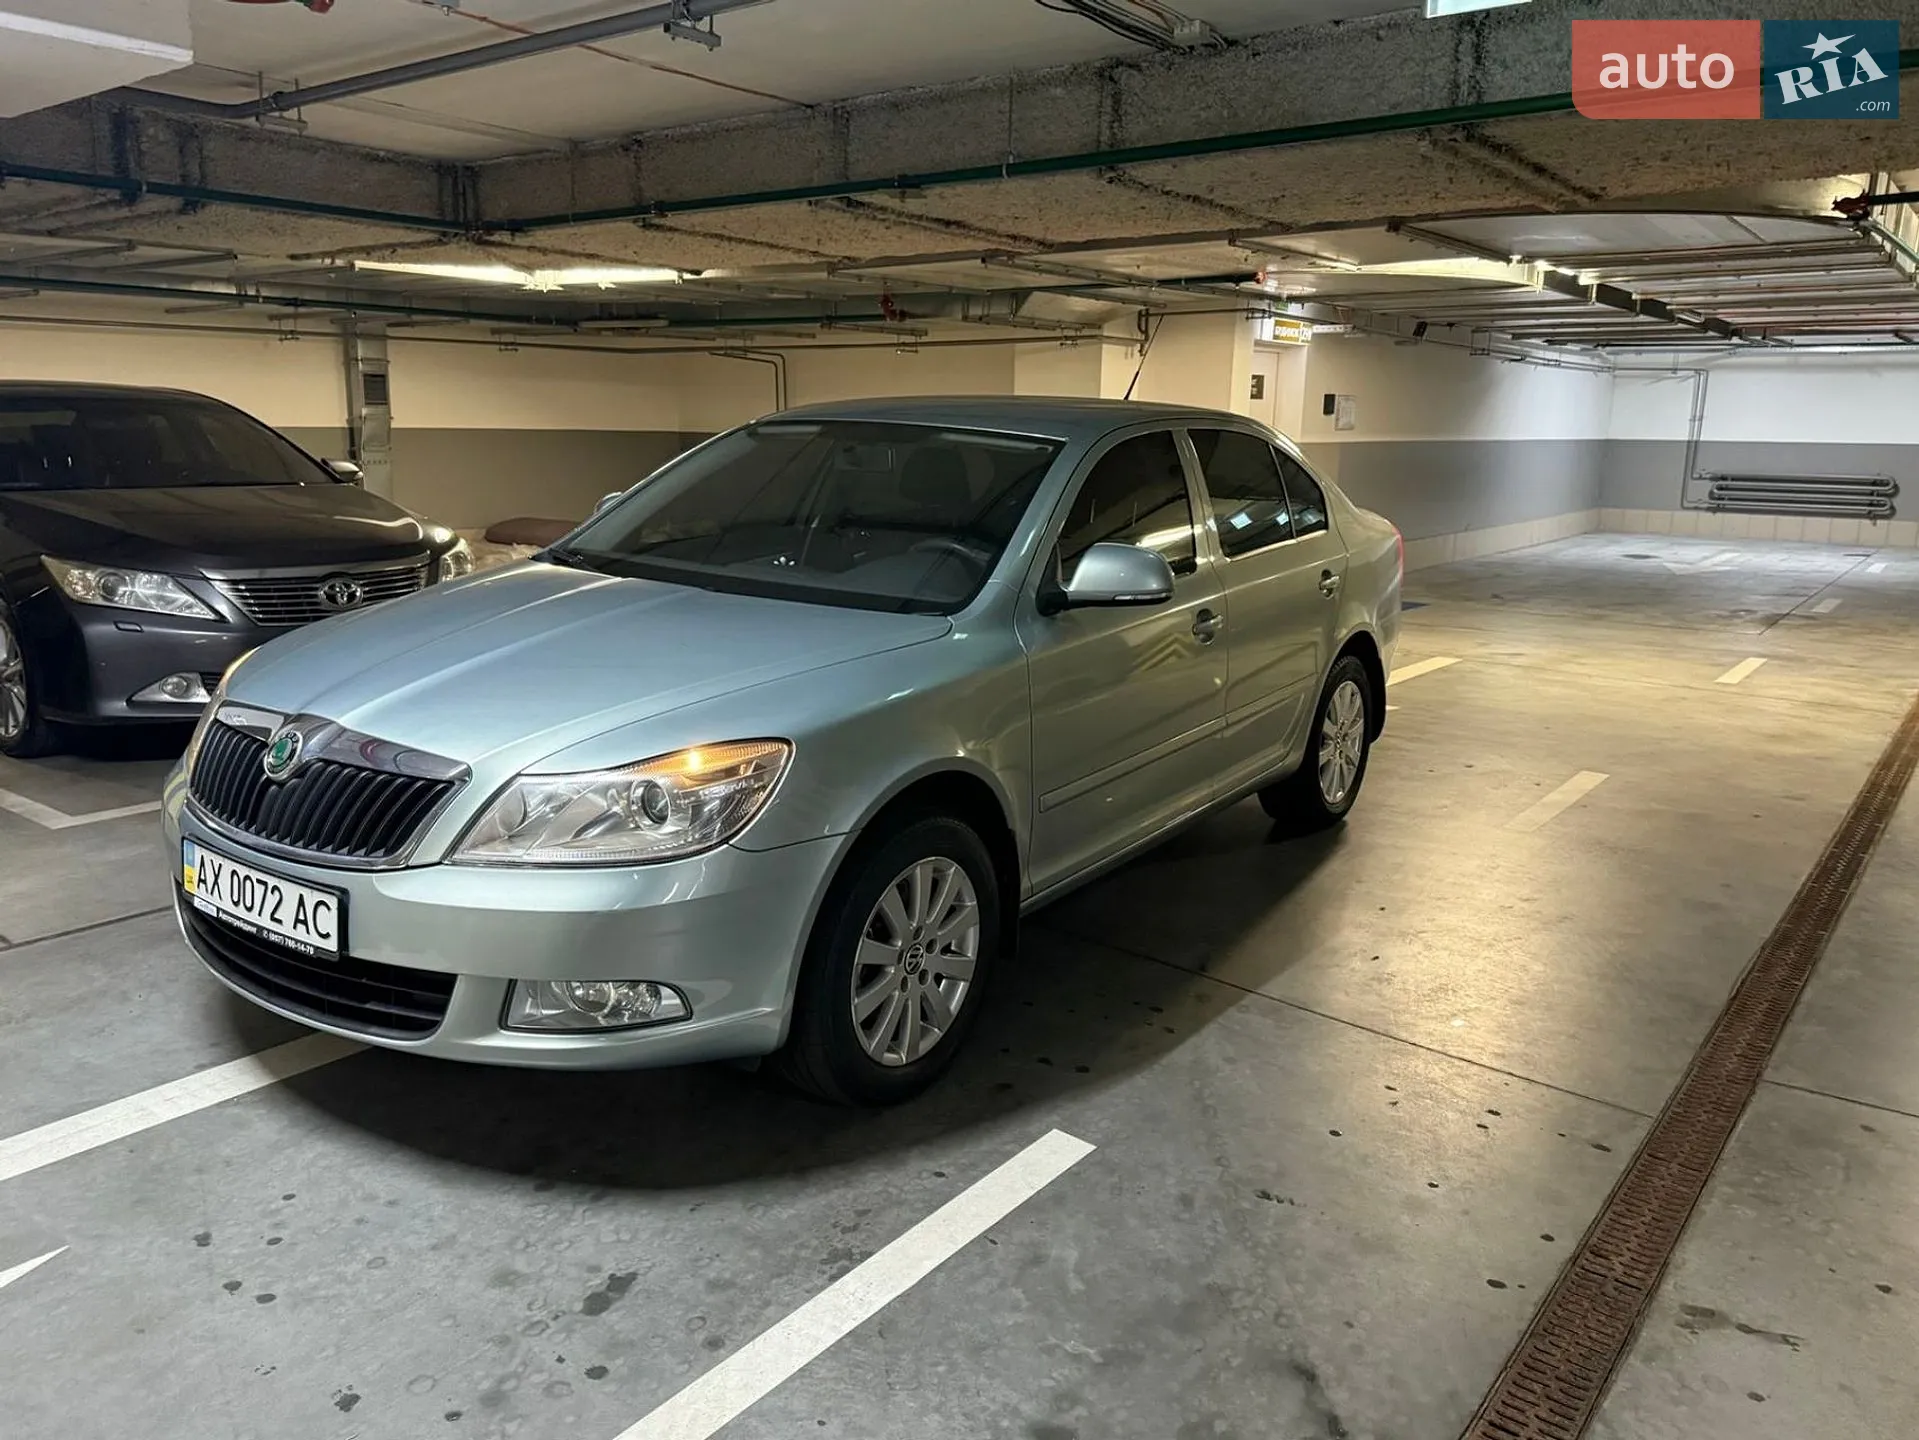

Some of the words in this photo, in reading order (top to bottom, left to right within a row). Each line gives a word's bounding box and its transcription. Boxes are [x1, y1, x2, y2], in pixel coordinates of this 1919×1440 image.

[197, 854, 223, 901] AX
[230, 869, 284, 926] 0072
[293, 893, 332, 940] AC
